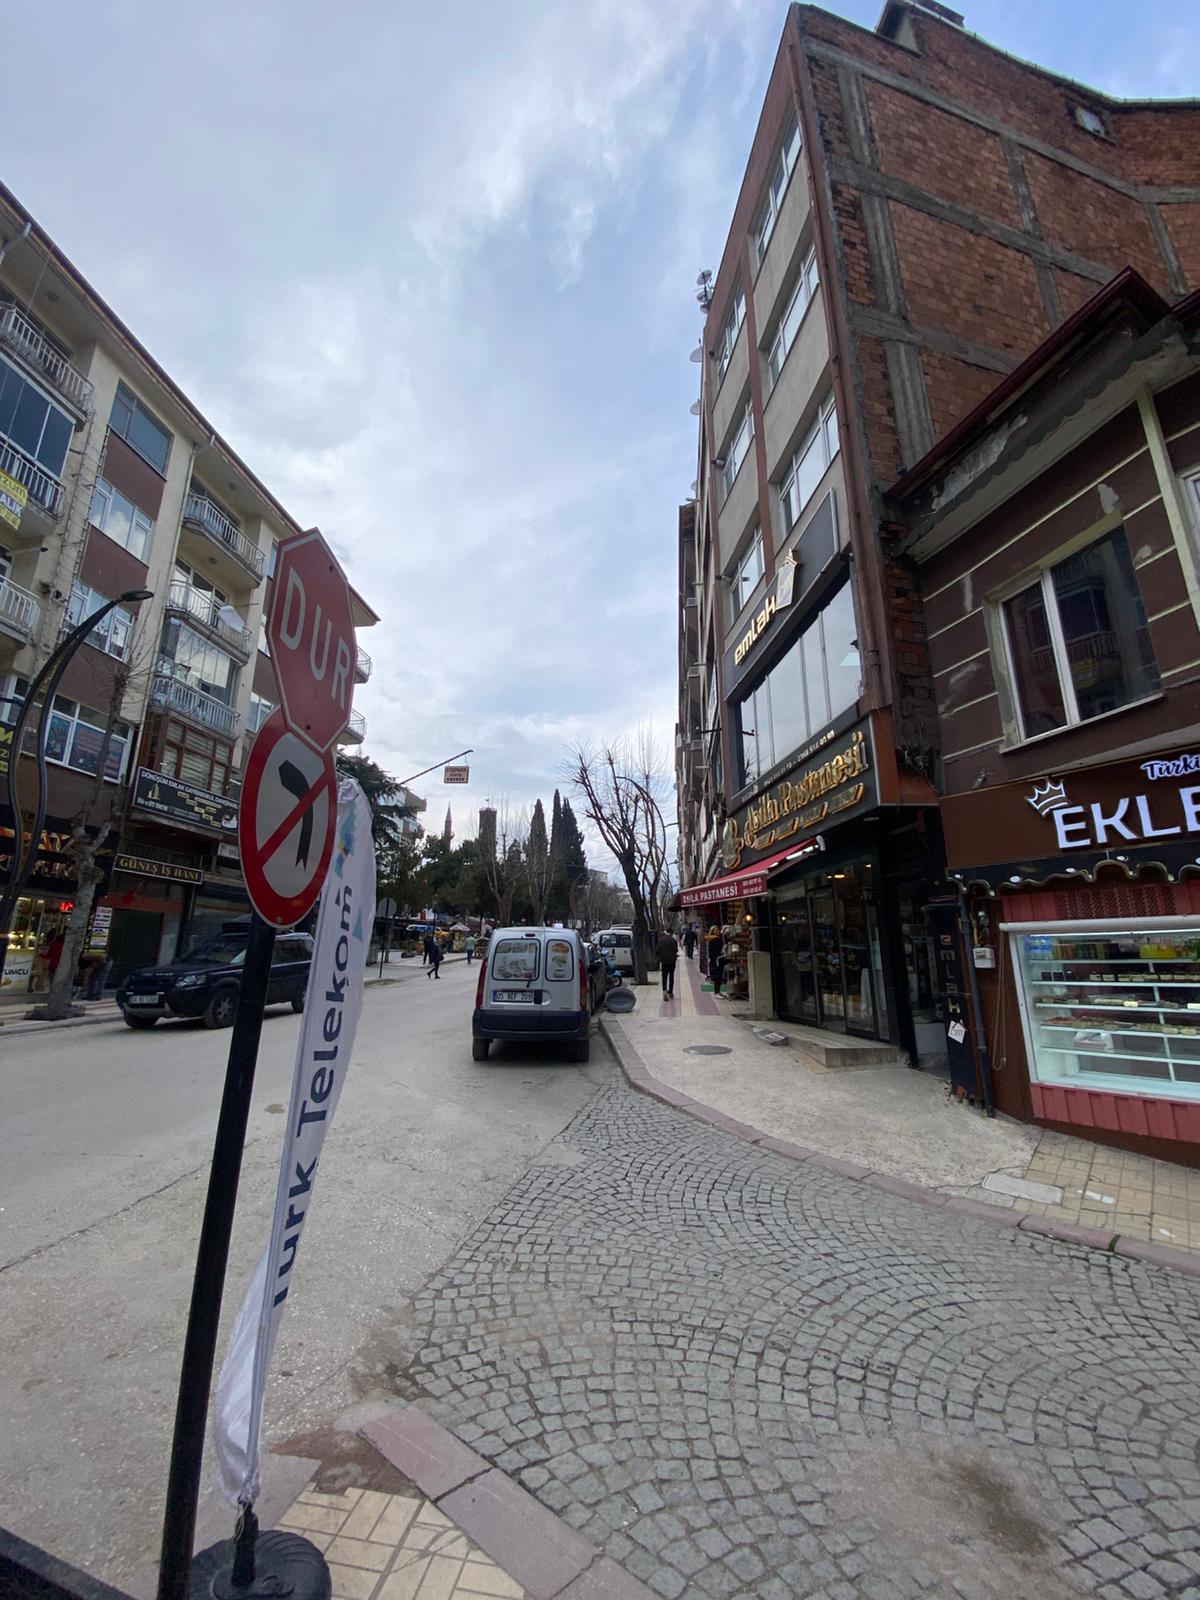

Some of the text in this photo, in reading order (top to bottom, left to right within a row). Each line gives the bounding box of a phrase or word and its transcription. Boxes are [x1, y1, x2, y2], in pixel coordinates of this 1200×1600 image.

[279, 566, 351, 709] DUR
[733, 594, 776, 666] emlak
[120, 857, 199, 881] GÜNEŞ İŞ HANI
[700, 882, 738, 901] PASTANESİ
[3, 968, 29, 976] UMCU
[296, 885, 352, 1138] Telekom
